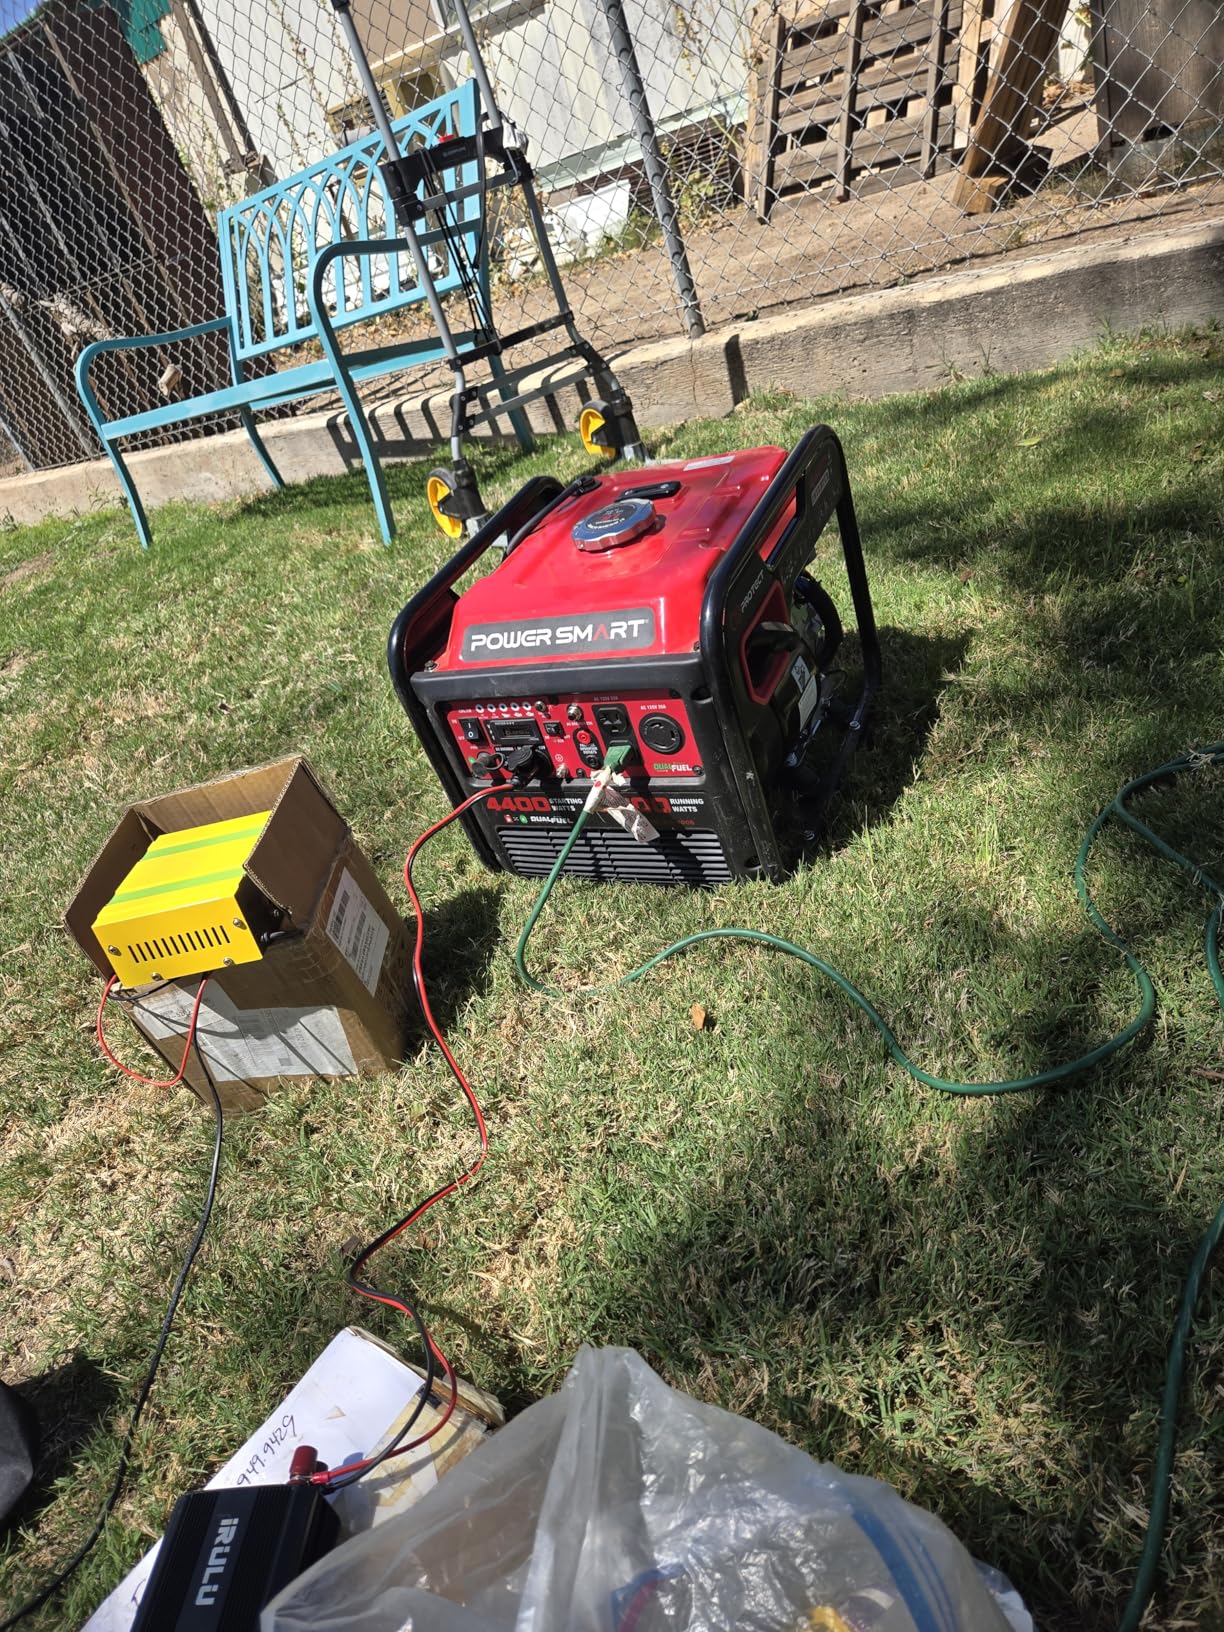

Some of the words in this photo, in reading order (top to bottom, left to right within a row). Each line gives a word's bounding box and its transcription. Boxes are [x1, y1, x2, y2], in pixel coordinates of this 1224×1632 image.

[470, 628, 551, 651] POWER
[556, 619, 645, 644] SMART
[486, 797, 551, 812] 4400
[237, 1415, 297, 1485] 949.9429
